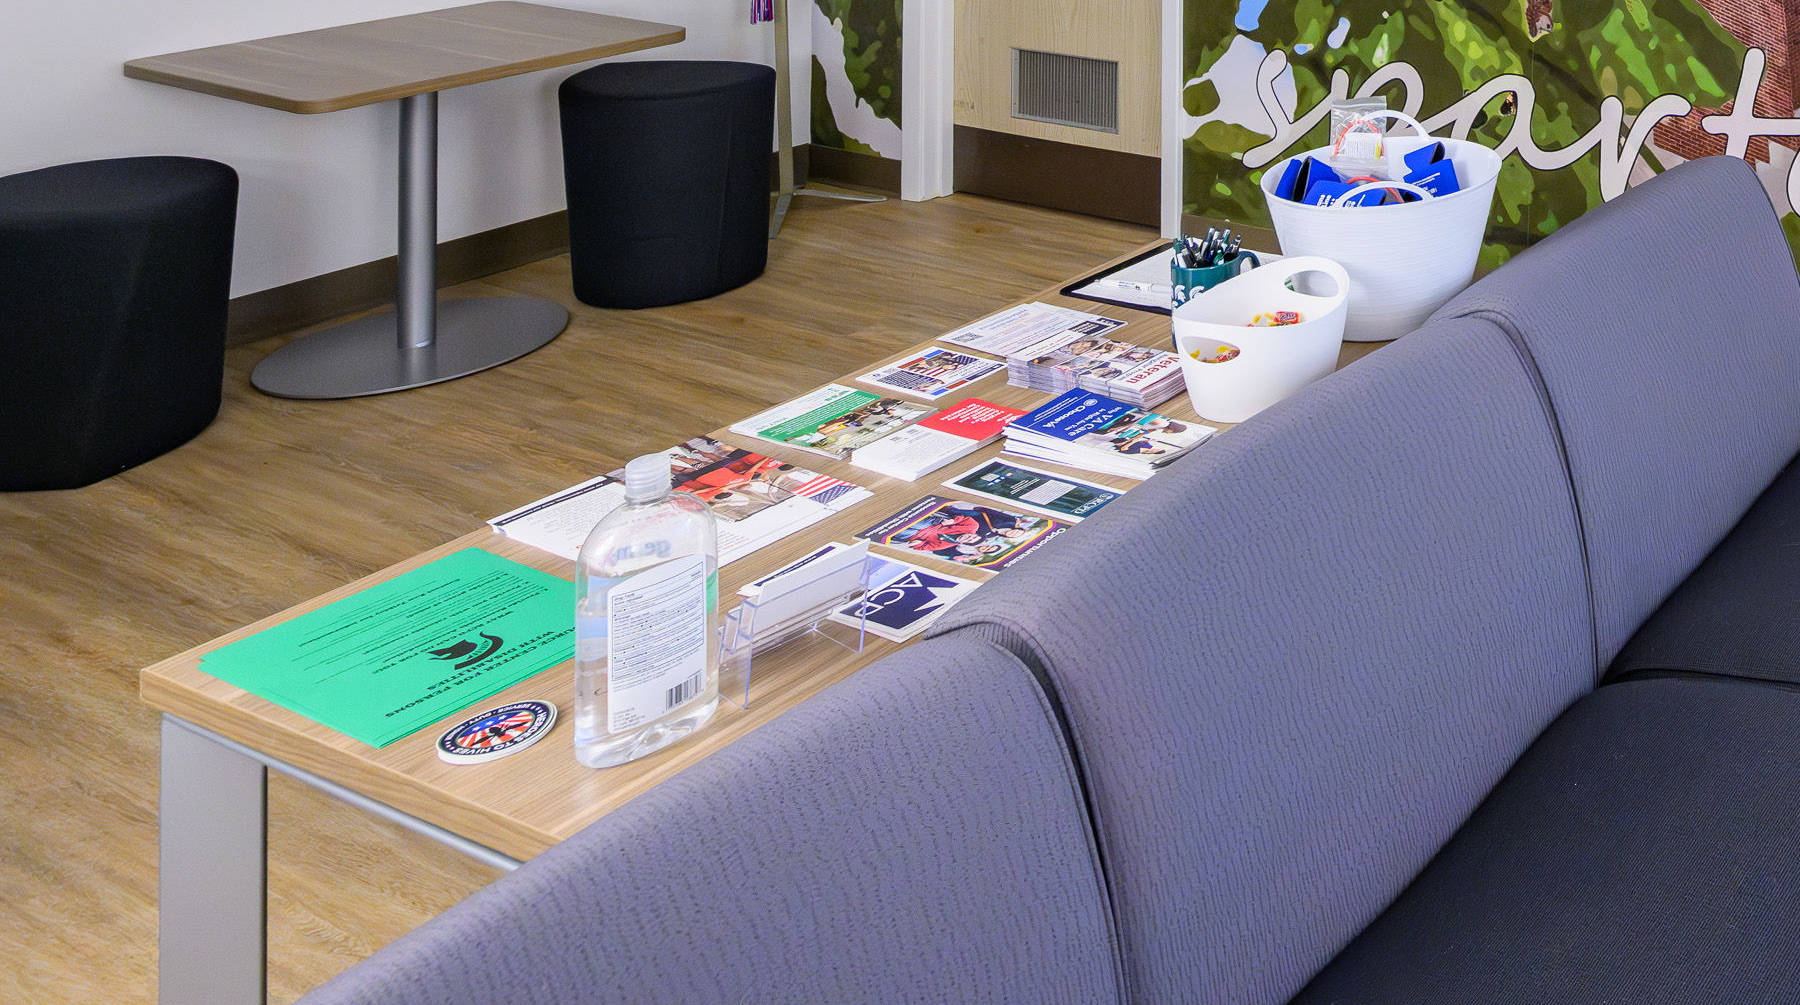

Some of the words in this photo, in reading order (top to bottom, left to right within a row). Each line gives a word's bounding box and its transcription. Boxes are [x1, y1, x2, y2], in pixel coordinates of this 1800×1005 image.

[1126, 356, 1180, 384] Veteran
[1093, 413, 1113, 424] VA
[1067, 423, 1095, 437] Care
[854, 573, 923, 617] ACP
[516, 630, 555, 647] WITH
[425, 647, 518, 690] DISABILITIES
[483, 645, 538, 671] CENTER
[452, 671, 483, 685] FOR
[383, 685, 454, 718] PERSONS
[518, 711, 548, 743] HEROES
[452, 746, 492, 755] HIVES
[493, 740, 515, 751] TO
